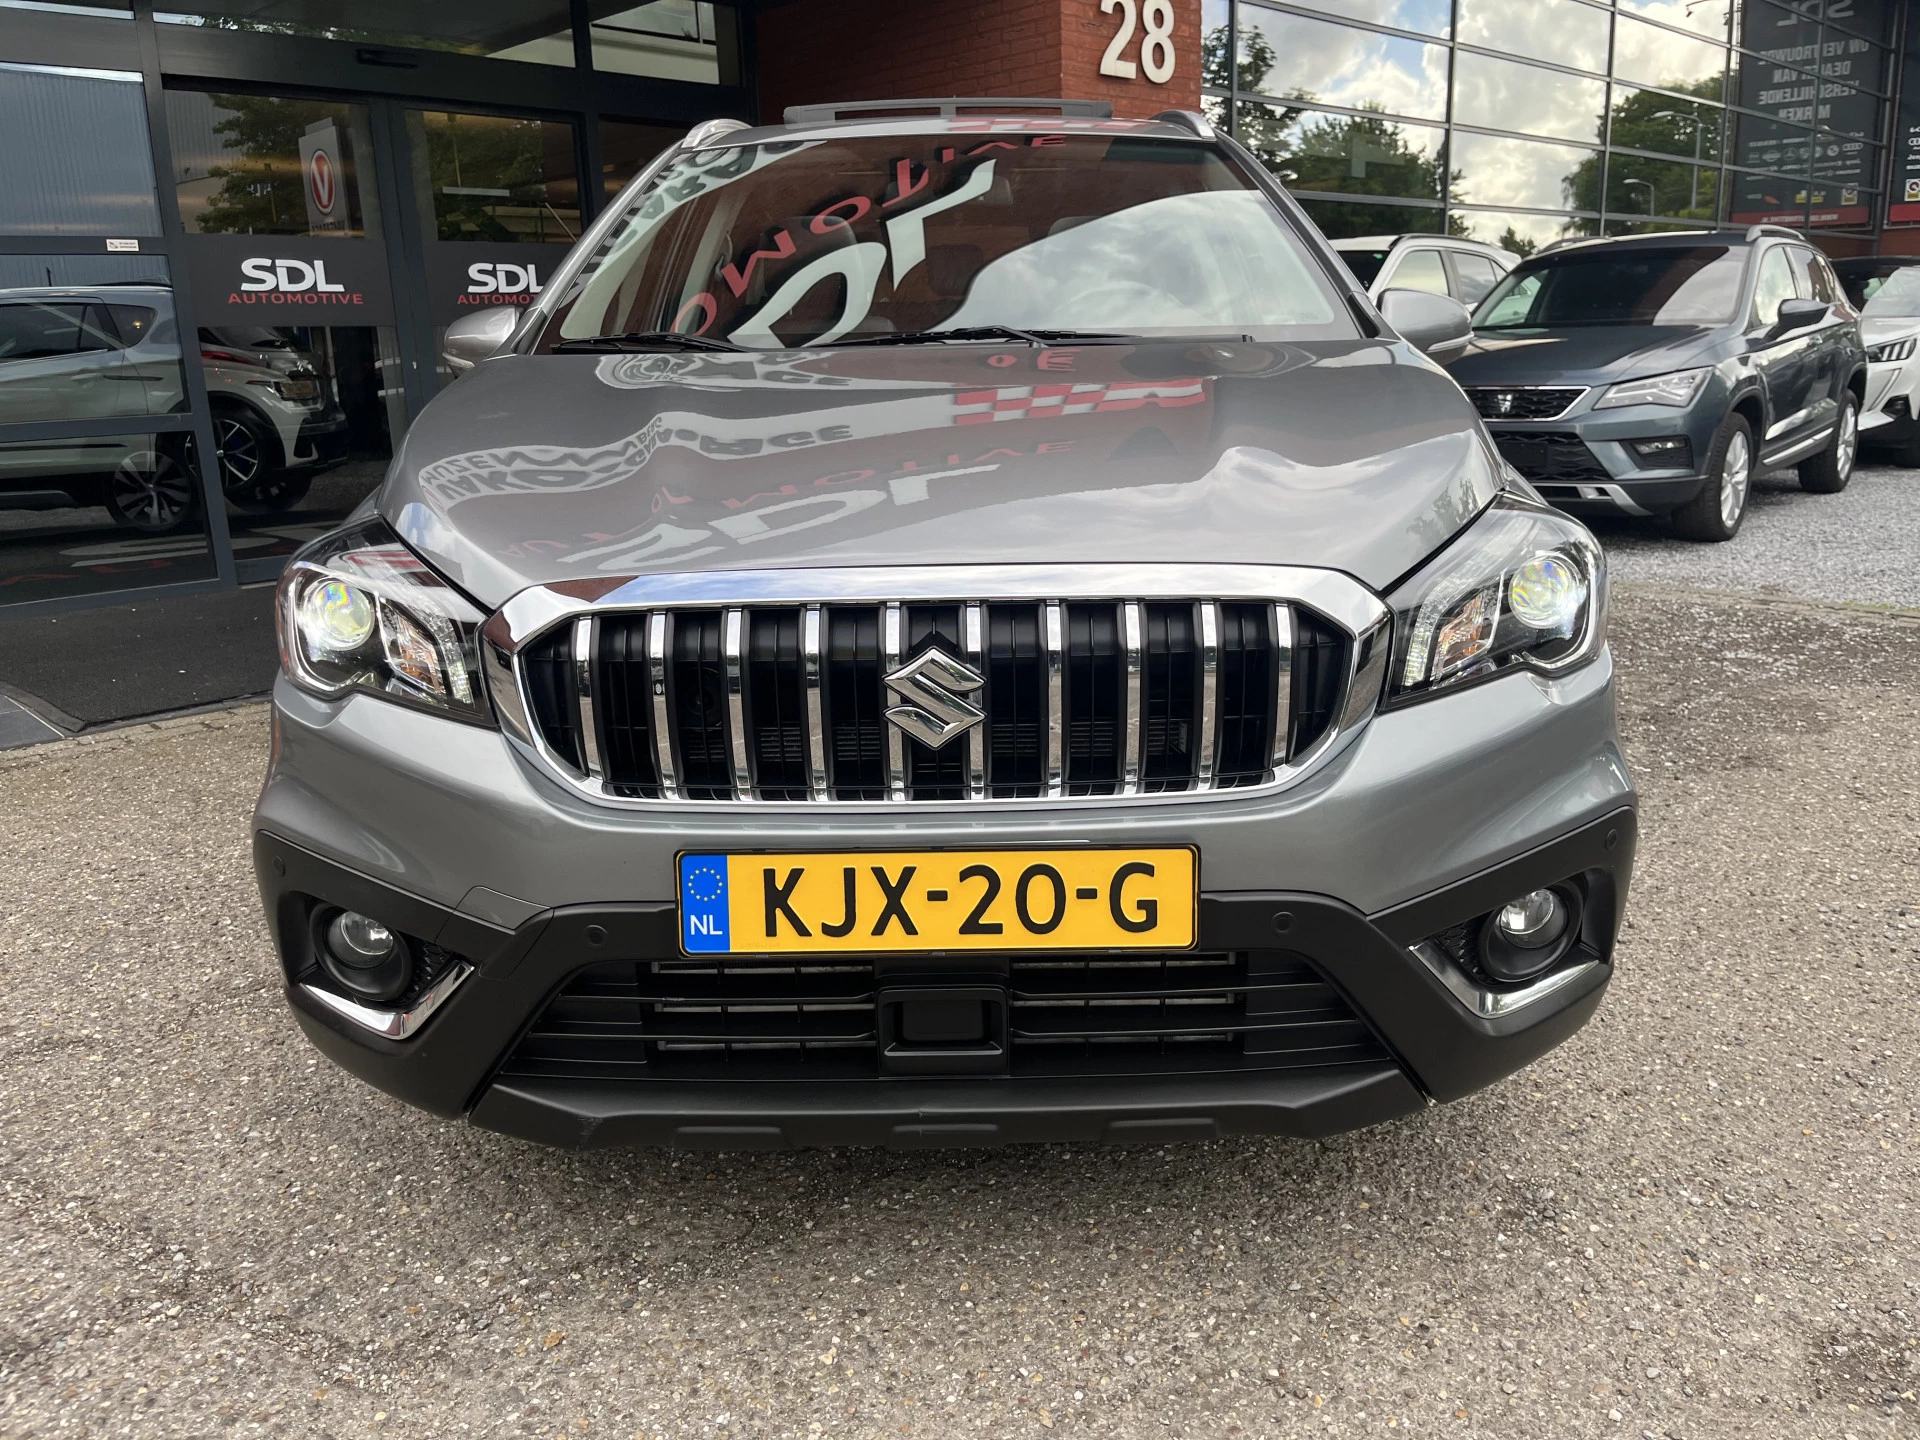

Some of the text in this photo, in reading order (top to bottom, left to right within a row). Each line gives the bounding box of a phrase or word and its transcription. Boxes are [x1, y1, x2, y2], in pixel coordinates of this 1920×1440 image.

[1099, 0, 1176, 84] 28
[240, 257, 345, 292] SDL
[467, 262, 544, 293] SDL
[227, 292, 364, 305] AUTOMOTIVE
[763, 862, 1159, 938] KJX-20-G
[689, 914, 724, 937] NL
